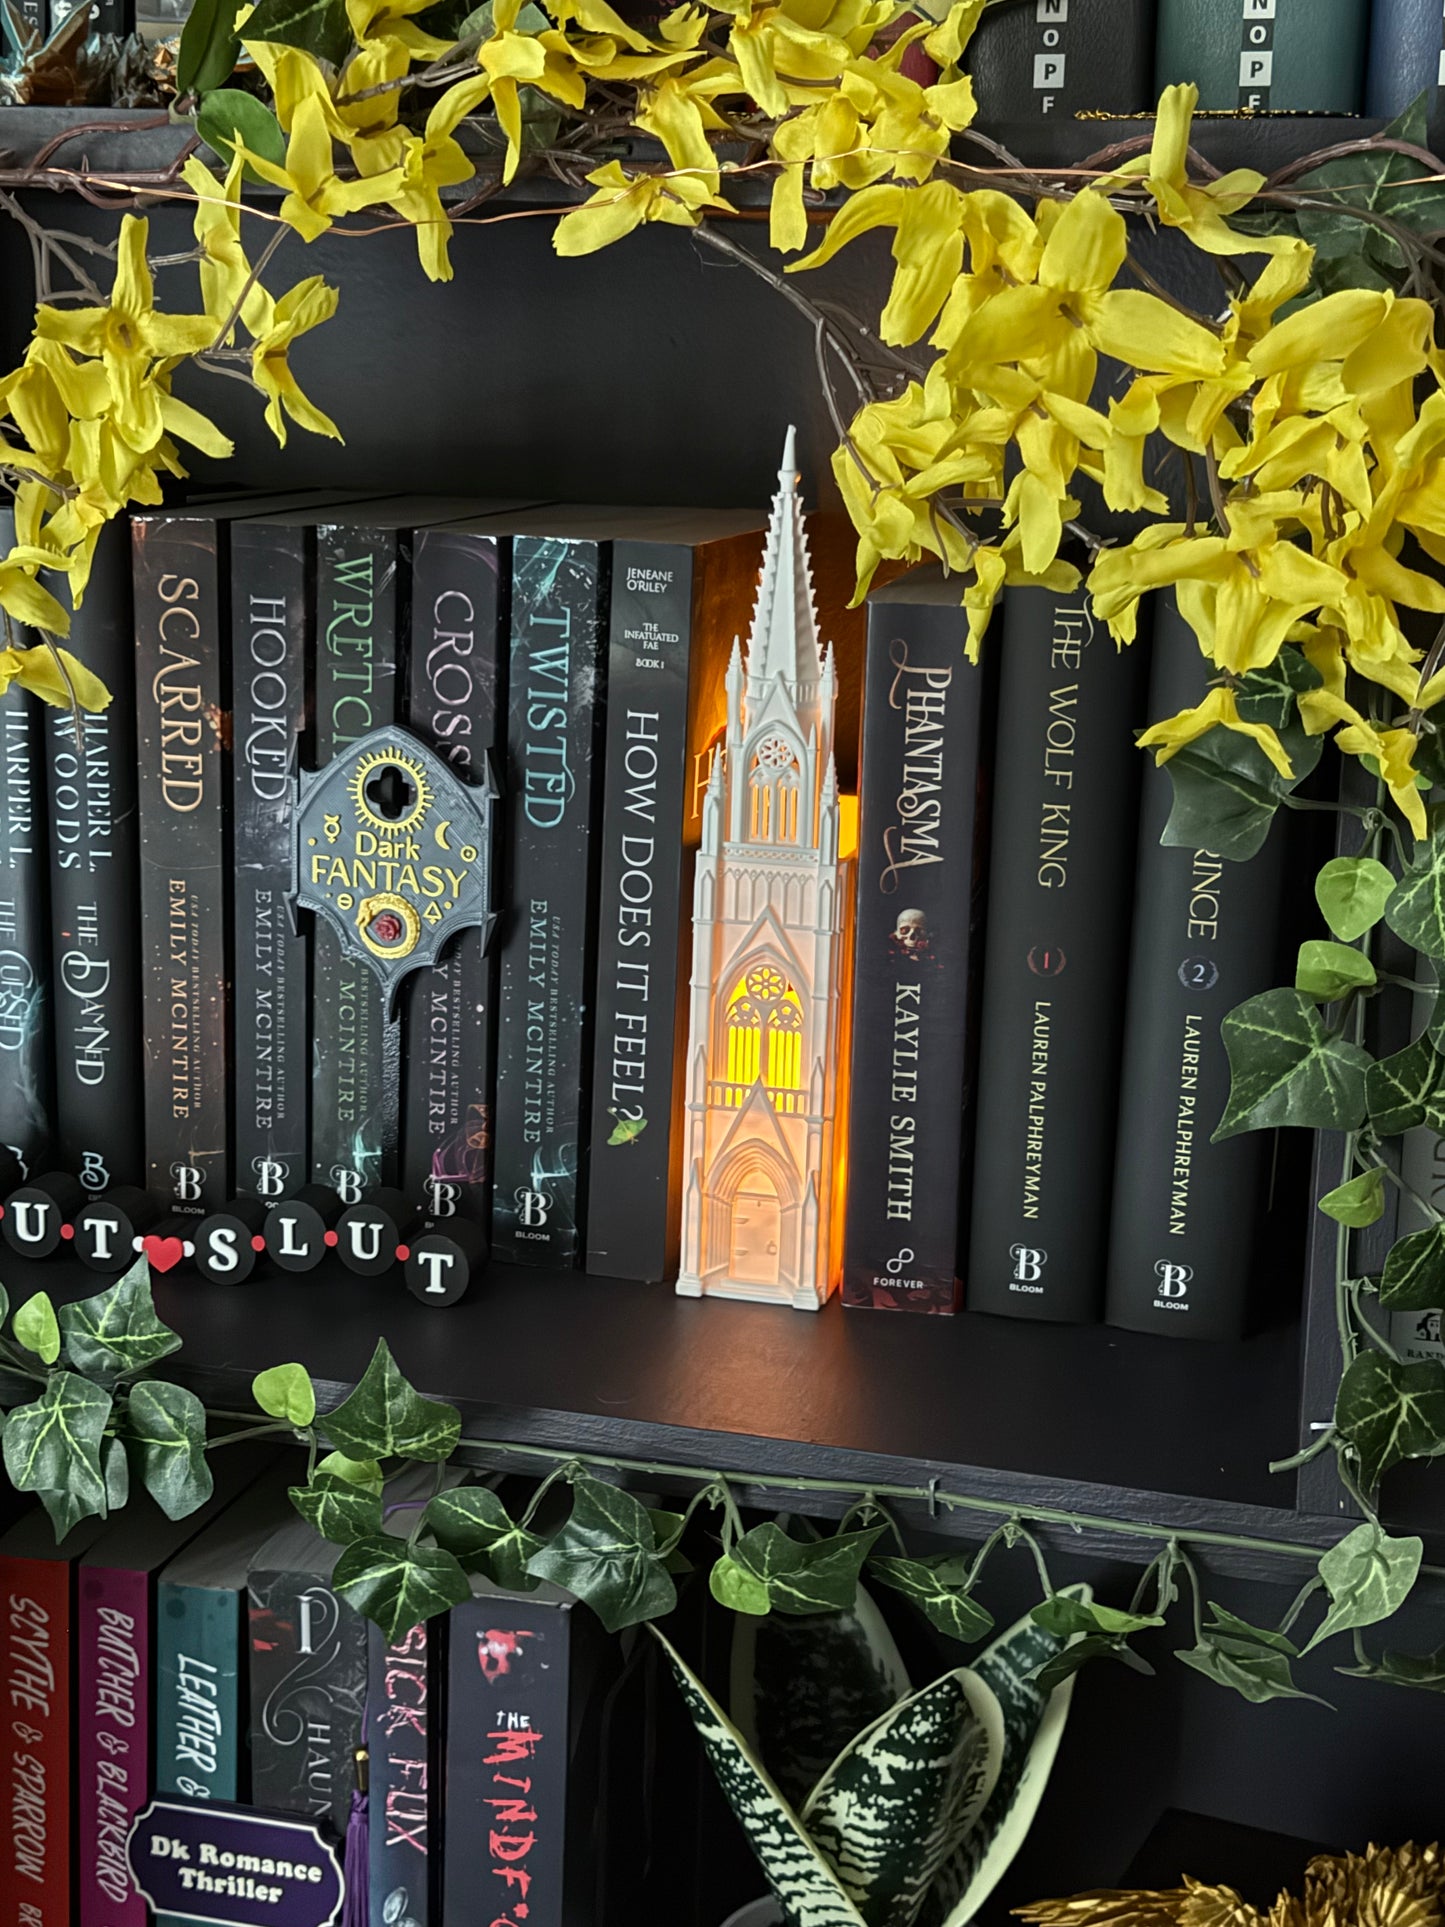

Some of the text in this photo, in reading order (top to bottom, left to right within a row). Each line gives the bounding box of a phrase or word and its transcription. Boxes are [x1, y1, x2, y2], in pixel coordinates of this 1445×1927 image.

[626, 567, 673, 582] JENEANE
[642, 623, 659, 632] THE
[153, 574, 203, 812] SCARRED
[245, 595, 287, 800] HOOKED
[624, 630, 679, 643] INFATUATED
[635, 658, 660, 668] BOOK
[643, 641, 659, 650] FAE
[525, 606, 575, 828] TWISTED
[880, 639, 952, 894] PHANTASMA
[1038, 594, 1094, 888] THE WOLF KING
[5, 711, 33, 869] HARPER L.
[53, 715, 81, 868] WOODS
[84, 714, 113, 873] HARPER L.
[356, 830, 420, 861] Dark
[0, 898, 16, 941] THE
[311, 855, 468, 898] FANTASY
[611, 709, 659, 1121] HOW DOES IT FEEL?
[1187, 849, 1222, 940] RINCE
[61, 901, 110, 1084] THE DAMNED
[169, 879, 189, 1118] EMILY MCINTIRE
[255, 889, 272, 1128] EMILY MCINTIRE
[524, 899, 547, 1142] EMILY MCINTIRE
[1192, 964, 1205, 982] 2
[338, 980, 355, 1121] MCINTIRE
[429, 991, 448, 1134] MCINTIRE
[887, 982, 921, 1221] KAYLIE SMITH
[1023, 1001, 1051, 1219] LAUREN PALPHREYMAN
[1169, 1015, 1202, 1235] LAUREN PALPHREYMAN
[515, 1230, 550, 1241] BLOOM
[873, 1277, 924, 1289] FOREVER
[1009, 1283, 1044, 1294] BLOOM
[1153, 1300, 1189, 1311] BLOOM
[9, 1594, 55, 1717] SCYTHE
[175, 1653, 221, 1774] LEATHER
[377, 1622, 428, 1736] SICK
[12, 1721, 44, 1744] &
[95, 1607, 139, 1903] BUTCHER & BLACKBIRD
[307, 1723, 332, 1816] HAUN
[496, 1711, 530, 1728] THE
[12, 1752, 46, 1883] SPARROW
[151, 1835, 322, 1882] Dk Romance
[178, 1867, 283, 1903] Thriller
